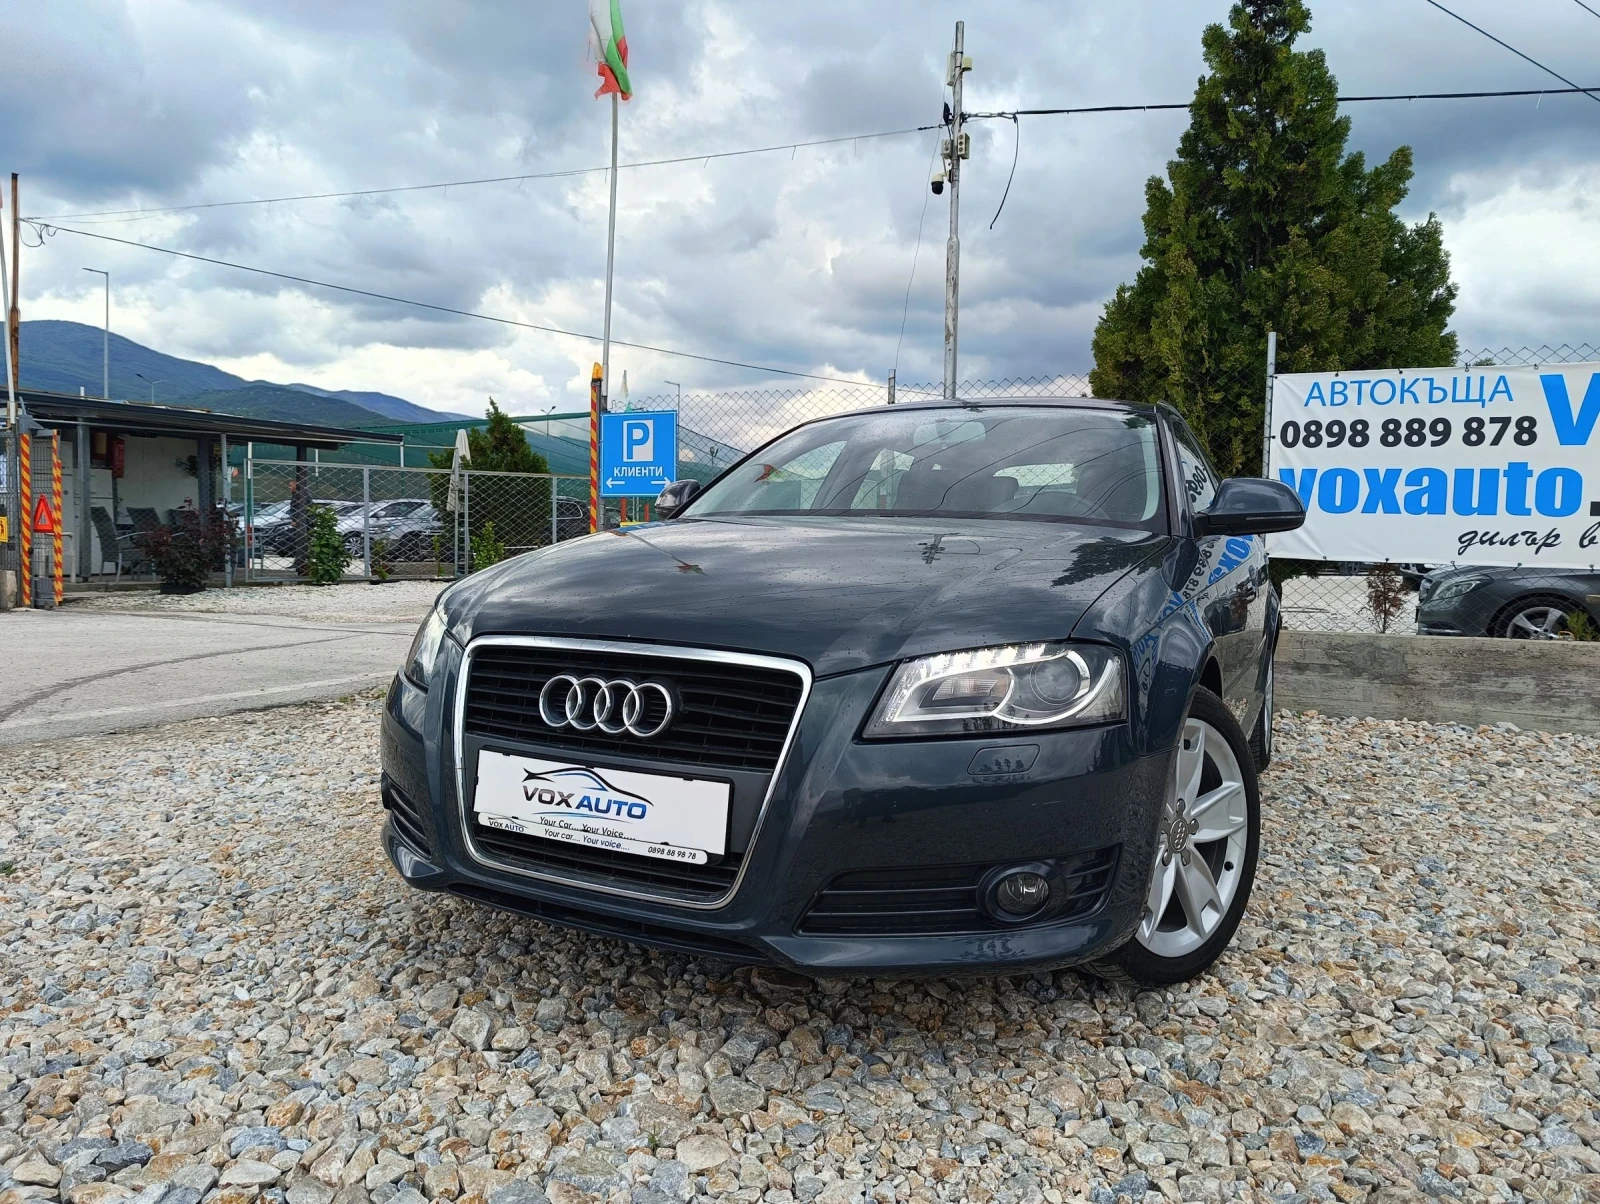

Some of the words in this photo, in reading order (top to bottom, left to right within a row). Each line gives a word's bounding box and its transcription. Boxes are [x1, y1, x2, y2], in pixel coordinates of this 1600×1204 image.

[1304, 375, 1514, 408] АВТОКЪЩА
[1280, 418, 1370, 448] 0898
[1379, 417, 1451, 447] 889
[1462, 415, 1537, 446] 878
[613, 466, 663, 477] КЛИЕНТИ
[522, 785, 575, 809] VOX
[575, 795, 647, 819] AUTO
[488, 820, 503, 829] VOX
[504, 823, 525, 833] AUTO
[540, 816, 556, 827] Your
[582, 823, 600, 835] Your
[544, 828, 560, 838] Your
[583, 835, 599, 845] Your
[647, 846, 665, 856] 0898
[666, 849, 676, 857] 88
[677, 851, 686, 859] 98
[687, 852, 697, 860] 78
